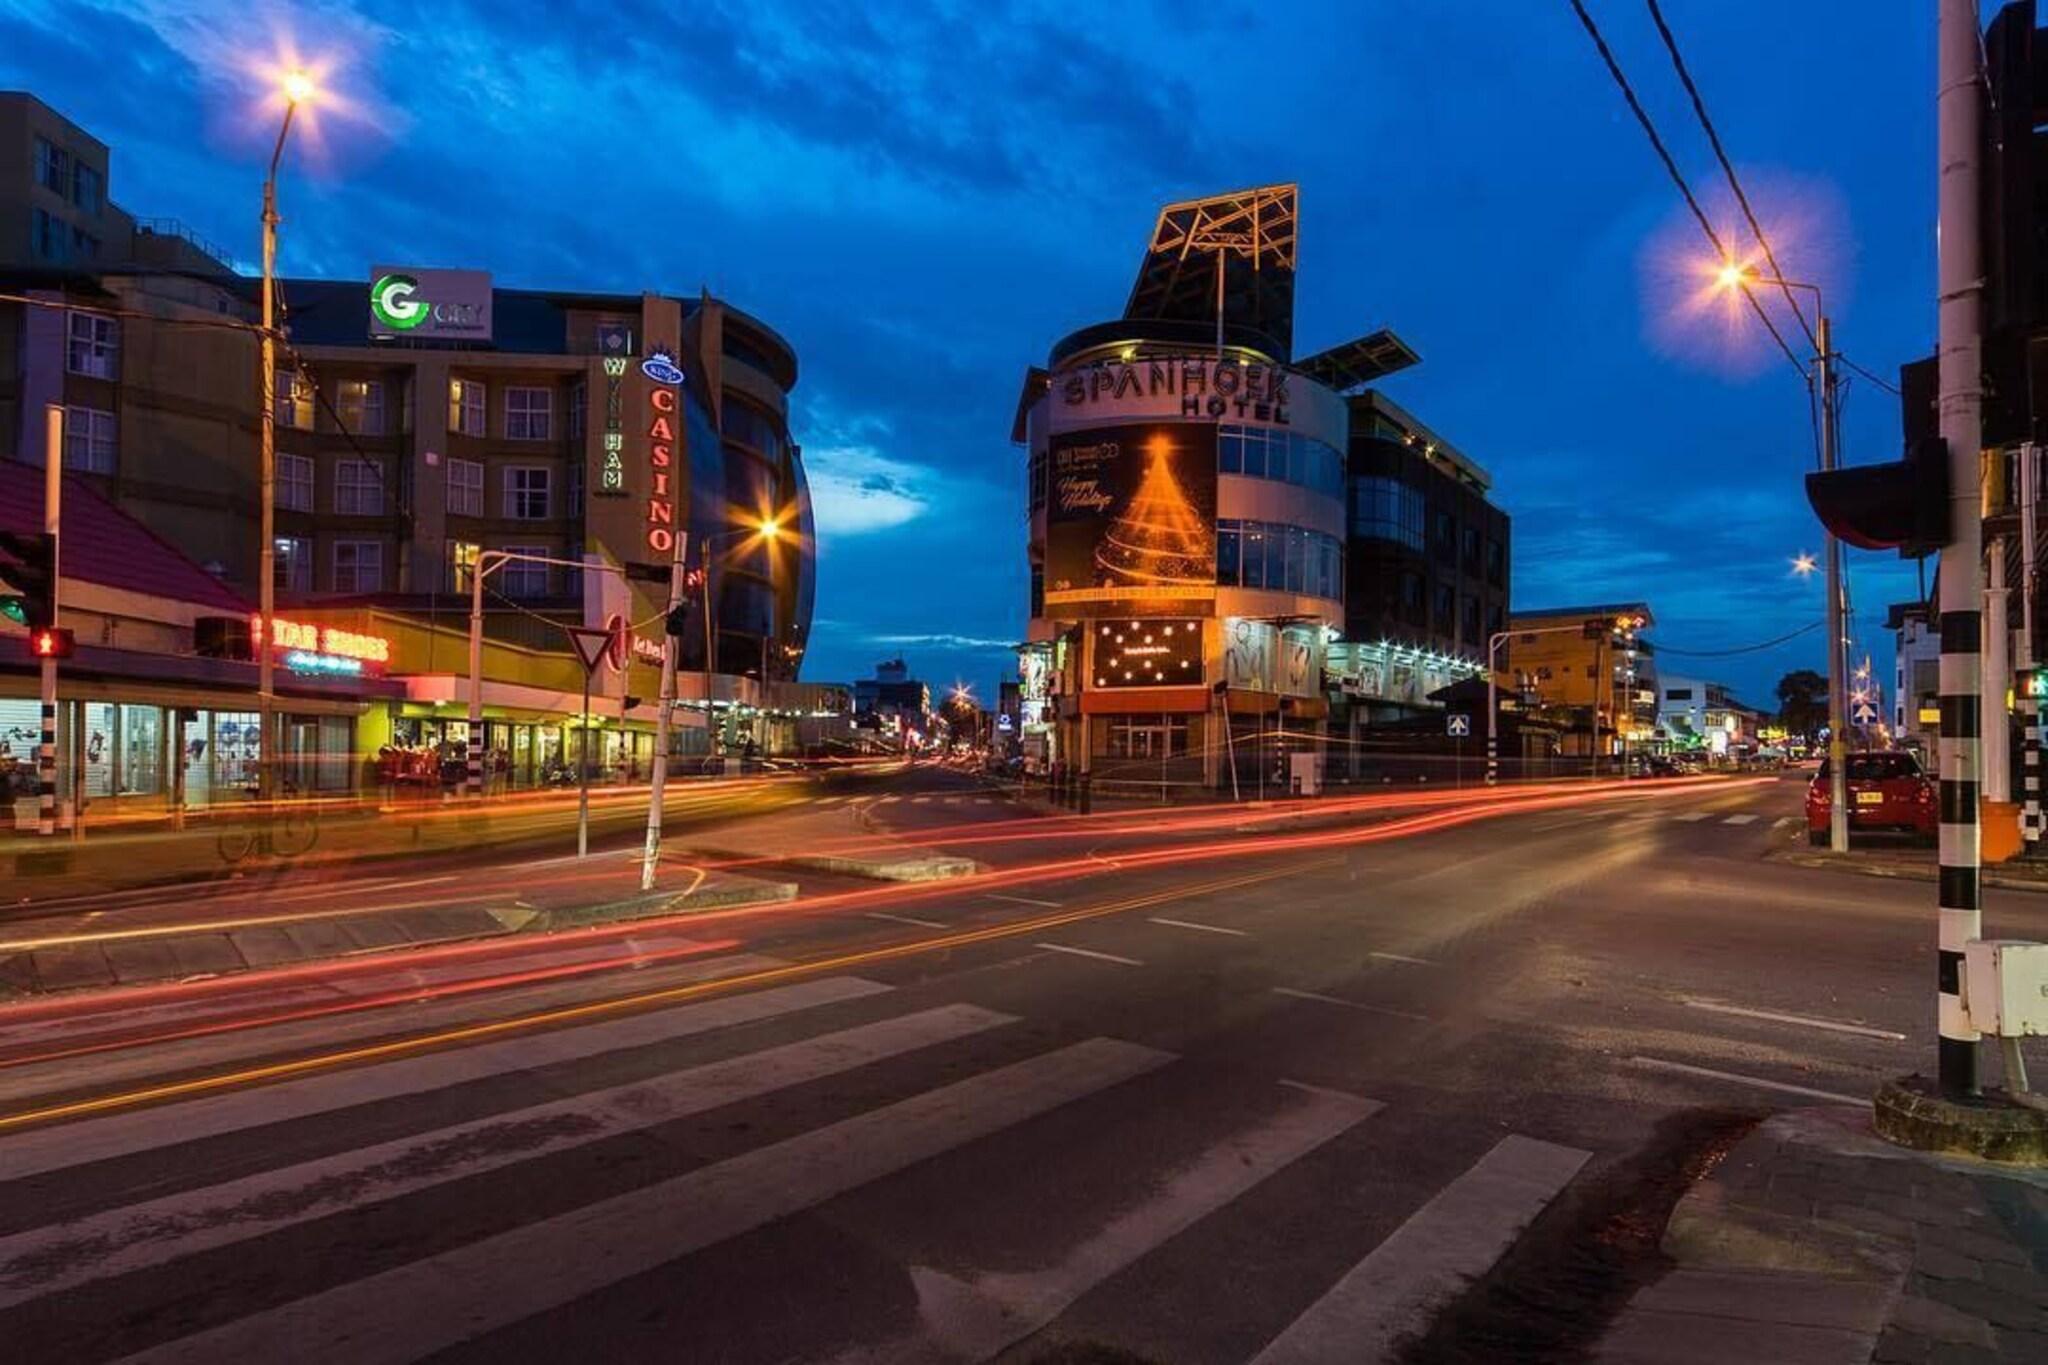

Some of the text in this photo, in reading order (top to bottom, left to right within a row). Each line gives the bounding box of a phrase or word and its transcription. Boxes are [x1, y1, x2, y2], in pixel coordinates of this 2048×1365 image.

[1064, 357, 1290, 407] SPANHOEK
[1182, 395, 1291, 424] HOTEL
[649, 389, 674, 551] CASINO
